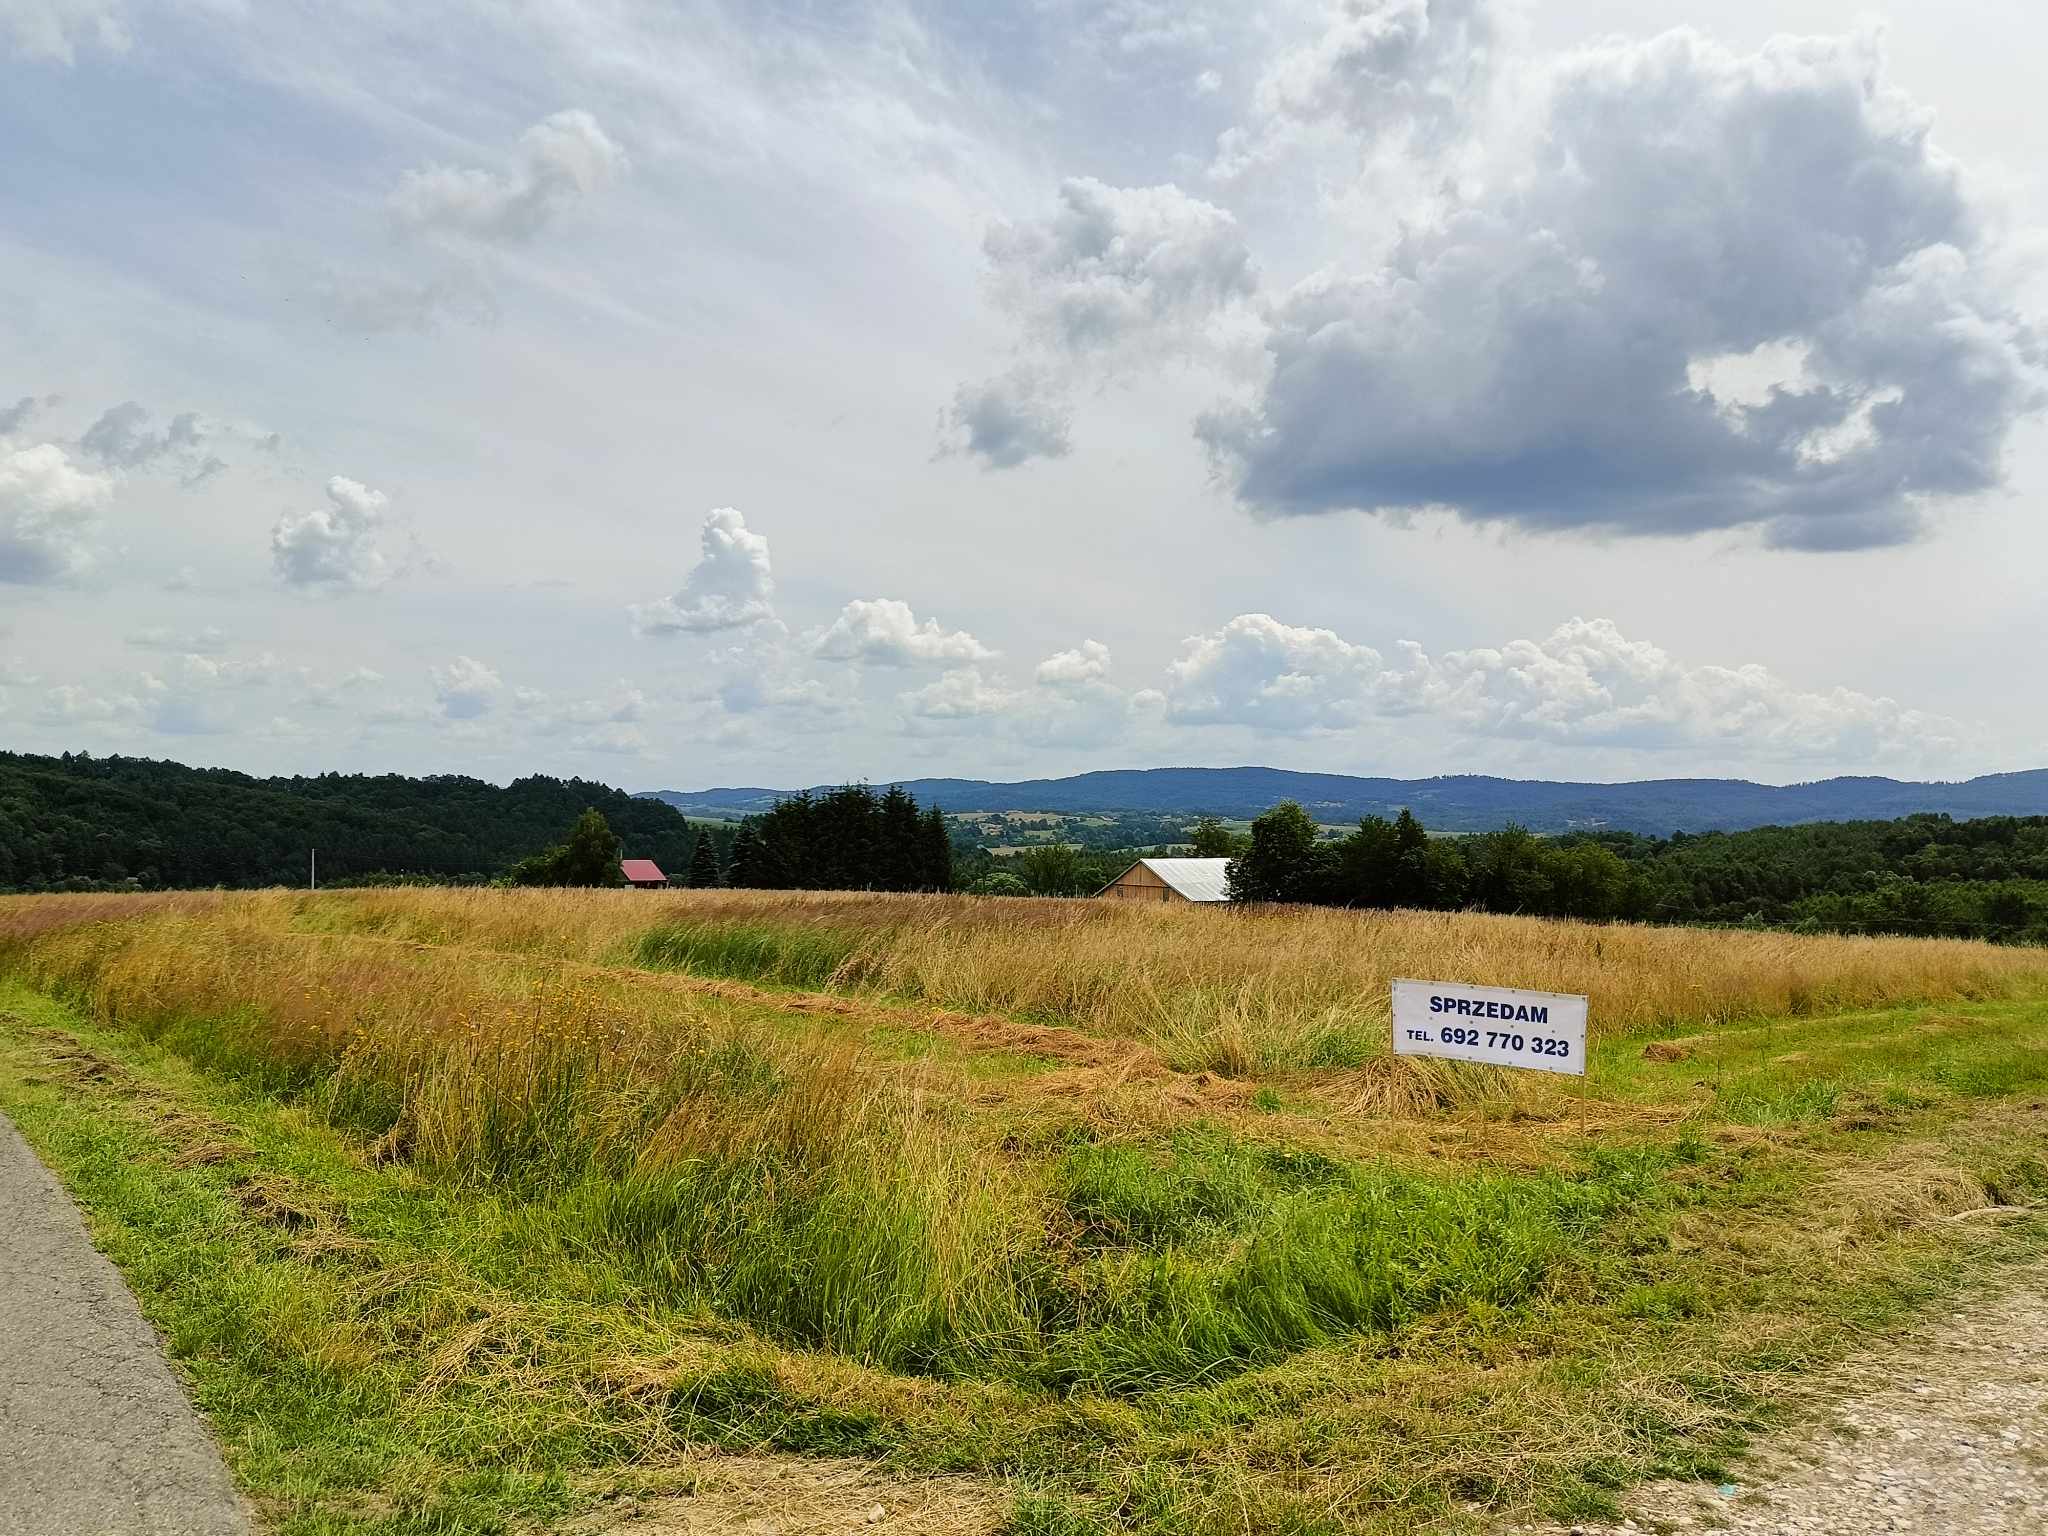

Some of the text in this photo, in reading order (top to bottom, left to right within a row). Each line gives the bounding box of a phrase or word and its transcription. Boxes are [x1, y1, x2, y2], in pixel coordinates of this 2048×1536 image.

[1429, 996, 1548, 1024] SPRZEDAM
[1406, 1027, 1569, 1057] TEL. 692 770 323
